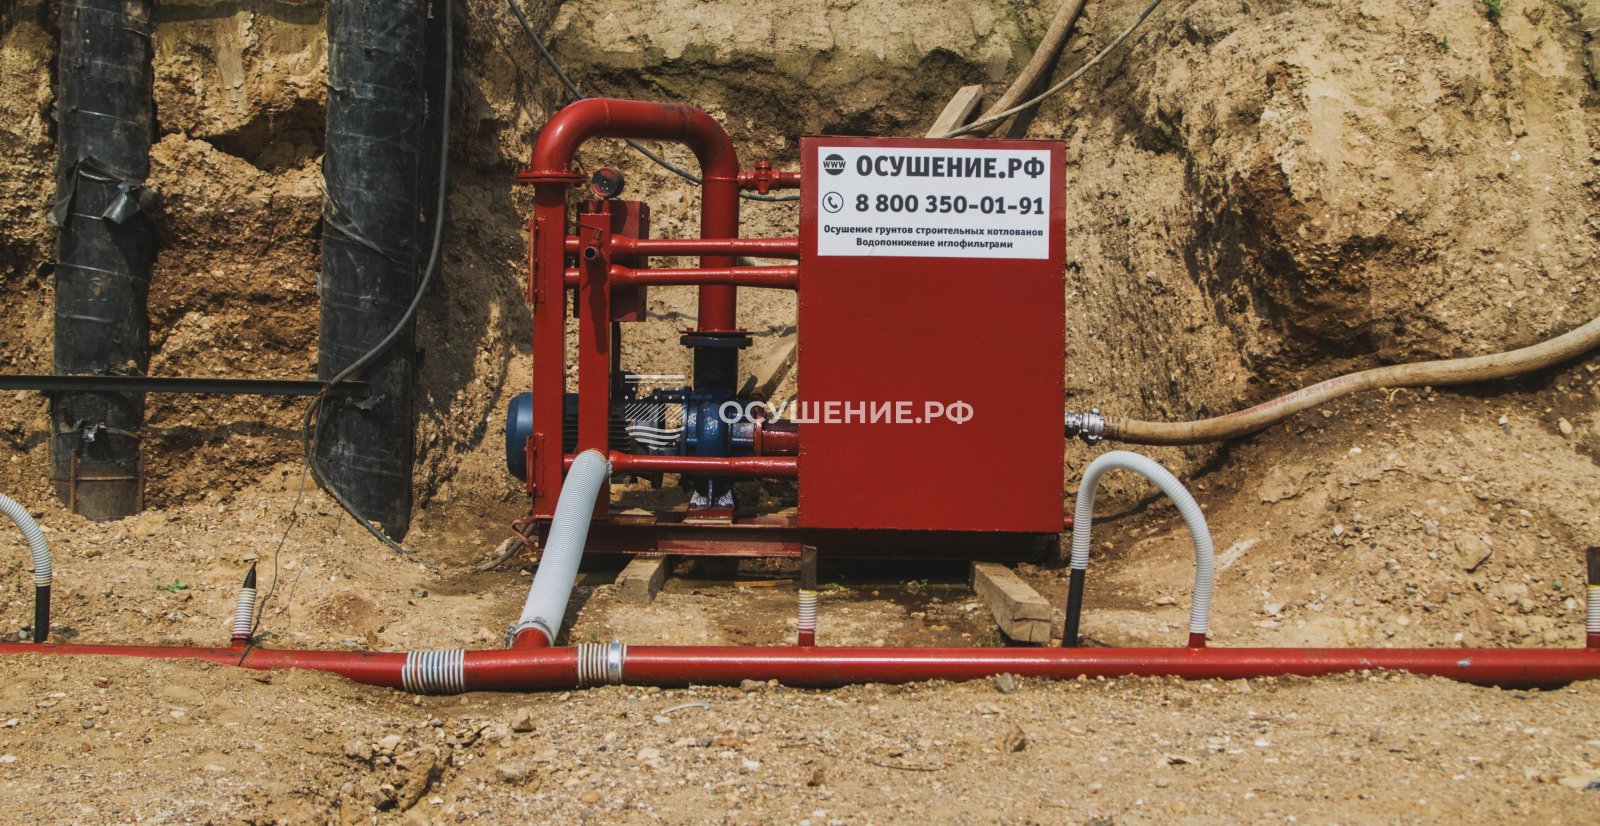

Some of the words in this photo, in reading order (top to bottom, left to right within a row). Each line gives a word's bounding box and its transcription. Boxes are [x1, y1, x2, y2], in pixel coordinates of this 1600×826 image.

[856, 155, 1045, 179] ОСУШЕНИЕ.РФ
[855, 194, 869, 212] 8
[875, 194, 919, 213] 800
[925, 195, 1044, 215] 350-01-91
[823, 224, 873, 234] Осушение
[875, 225, 913, 235] грунтов
[915, 227, 985, 235] строительных
[987, 229, 1044, 237] котлованов
[856, 237, 935, 248] Водопонижение
[937, 239, 1013, 249] иглофильтрами
